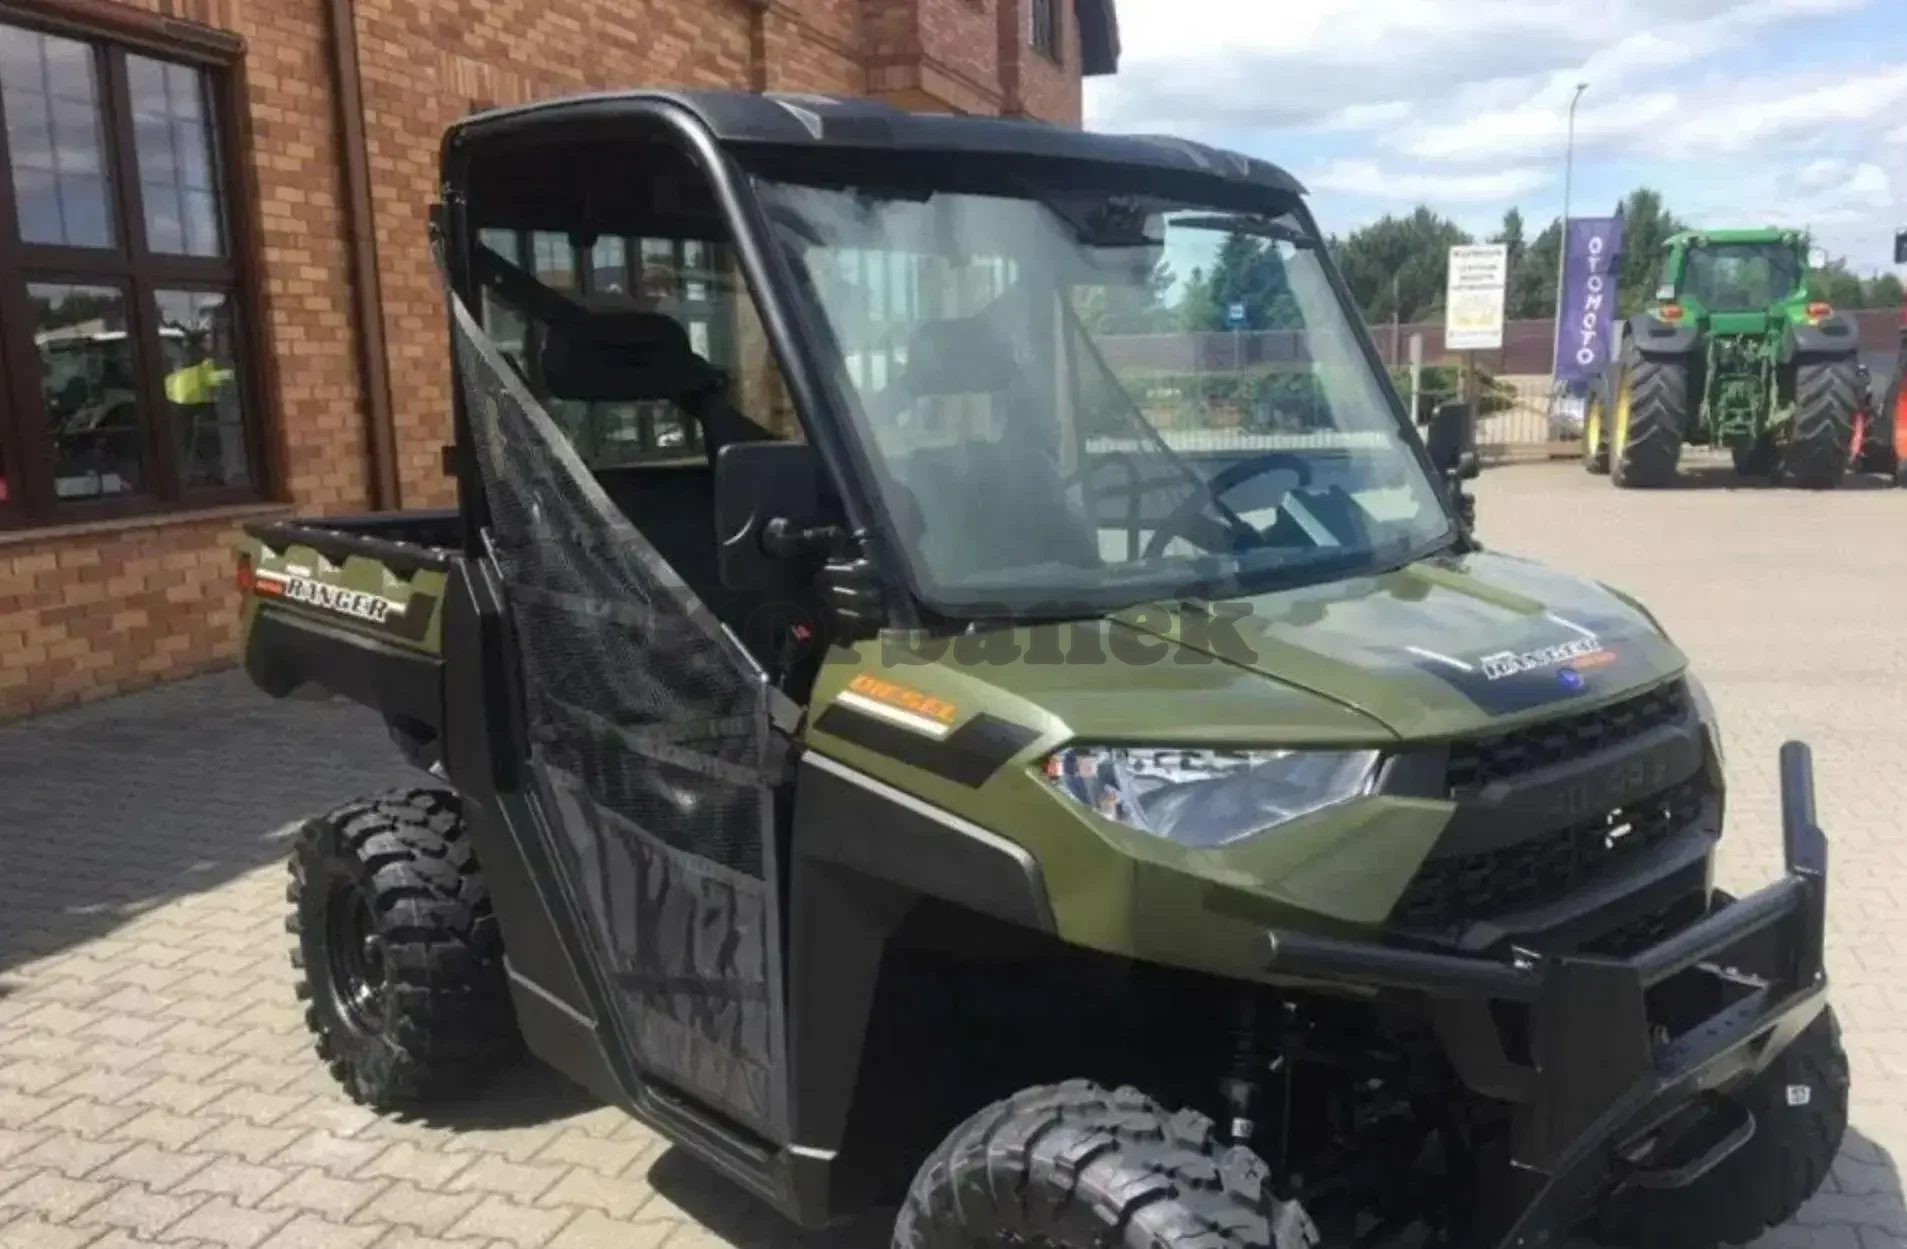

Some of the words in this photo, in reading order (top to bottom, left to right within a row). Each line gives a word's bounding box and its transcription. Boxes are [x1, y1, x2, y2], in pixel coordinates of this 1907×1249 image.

[1577, 235, 1603, 365] OTOMOTO
[286, 577, 388, 622] RANGER
[851, 674, 956, 722] DIESEL
